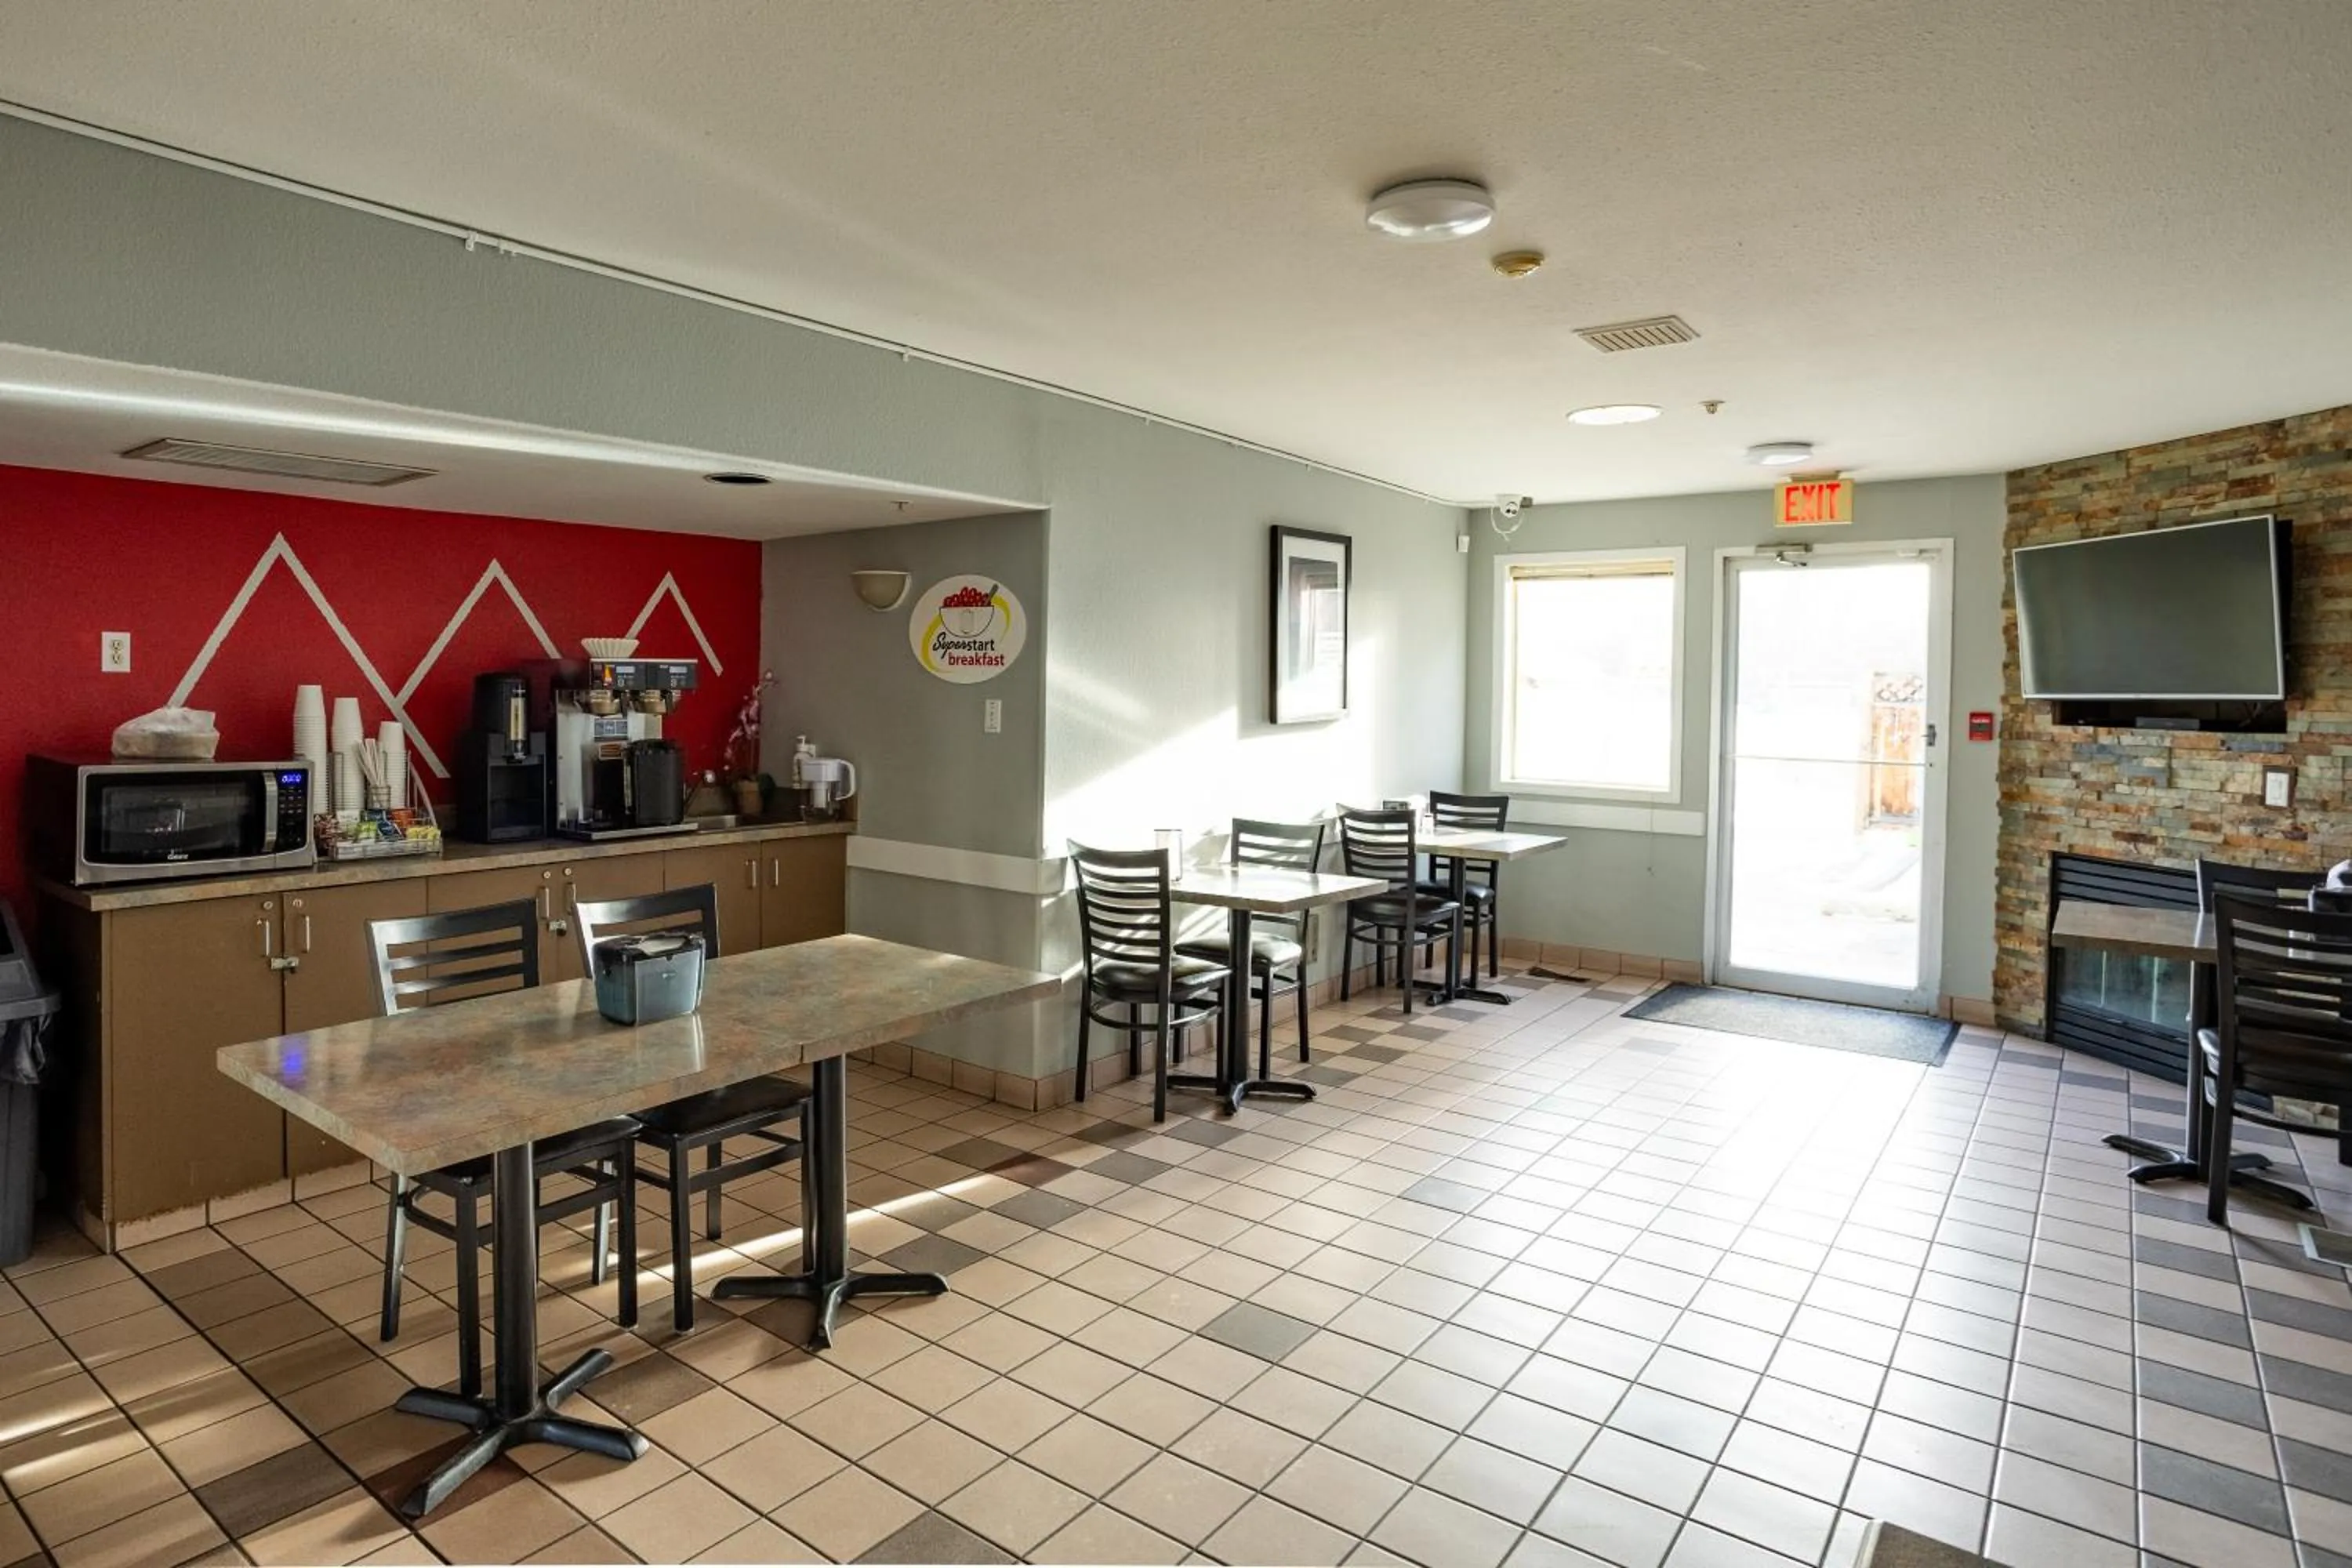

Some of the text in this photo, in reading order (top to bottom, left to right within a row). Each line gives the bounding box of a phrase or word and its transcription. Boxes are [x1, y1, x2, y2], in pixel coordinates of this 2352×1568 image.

[1784, 482, 1841, 522] EXIT
[932, 631, 995, 659] Superstart
[948, 652, 1005, 666] breakfast
